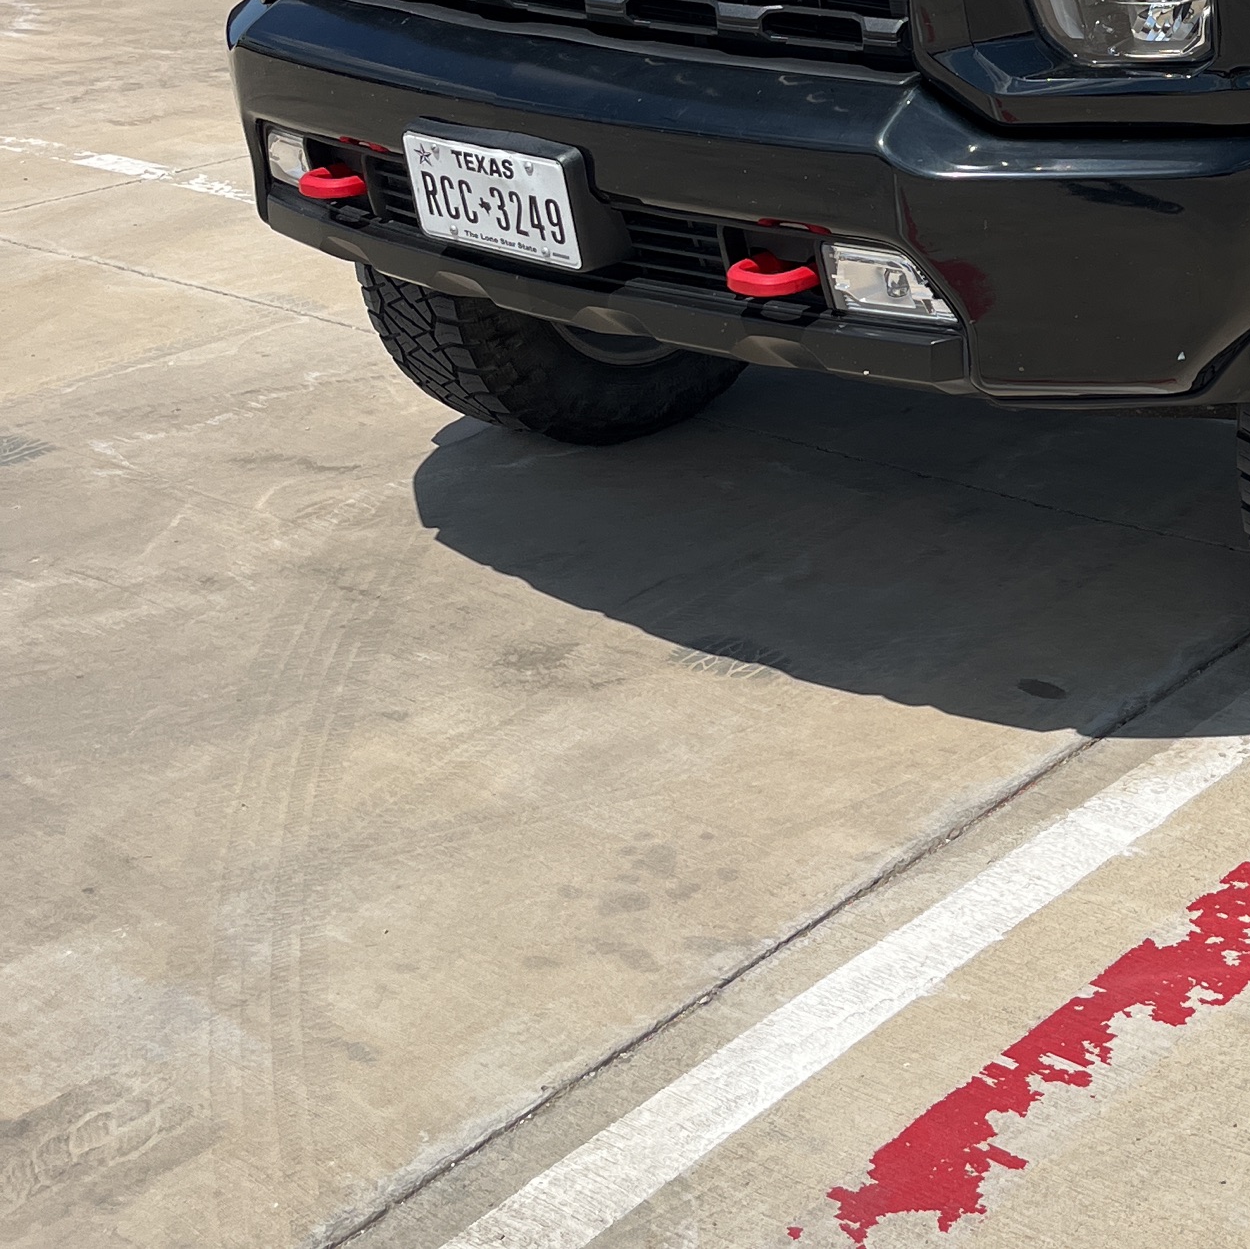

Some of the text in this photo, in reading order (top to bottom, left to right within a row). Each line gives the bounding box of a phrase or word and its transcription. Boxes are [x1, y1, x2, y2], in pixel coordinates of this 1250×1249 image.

[450, 150, 514, 180] TEXAS
[420, 170, 566, 245] RCC 3249
[464, 229, 538, 254] The Lone Star State
